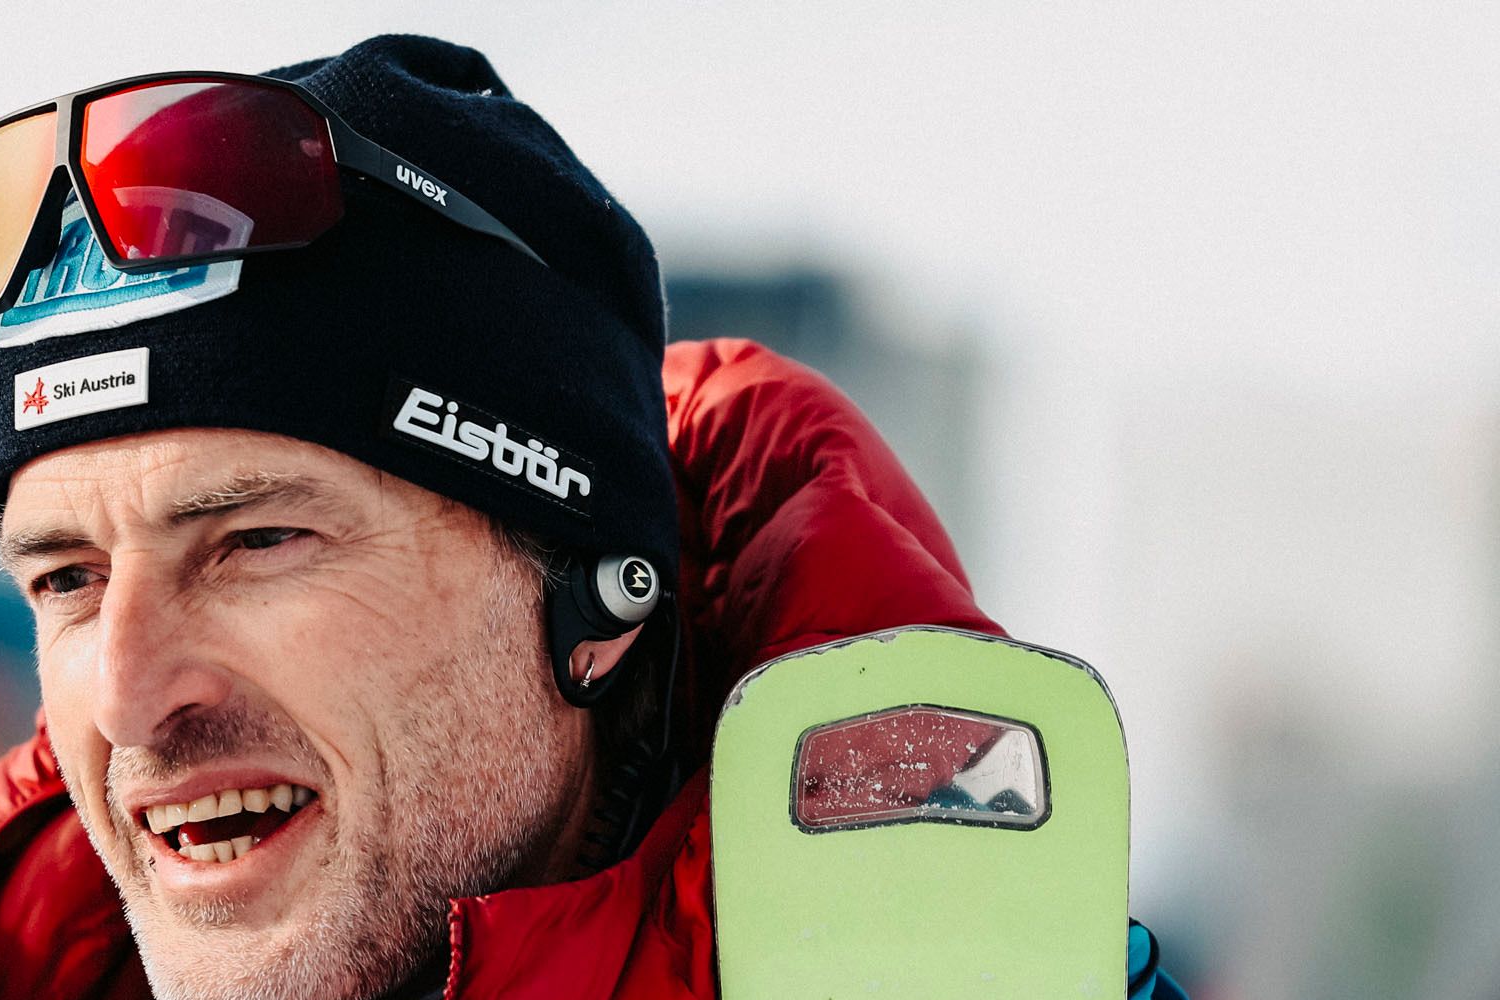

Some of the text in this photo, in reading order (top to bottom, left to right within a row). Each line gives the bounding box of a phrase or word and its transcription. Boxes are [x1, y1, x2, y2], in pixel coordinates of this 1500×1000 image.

[396, 164, 448, 207] uvex
[53, 371, 136, 400] Ski Austria
[393, 387, 591, 500] Eisbär
